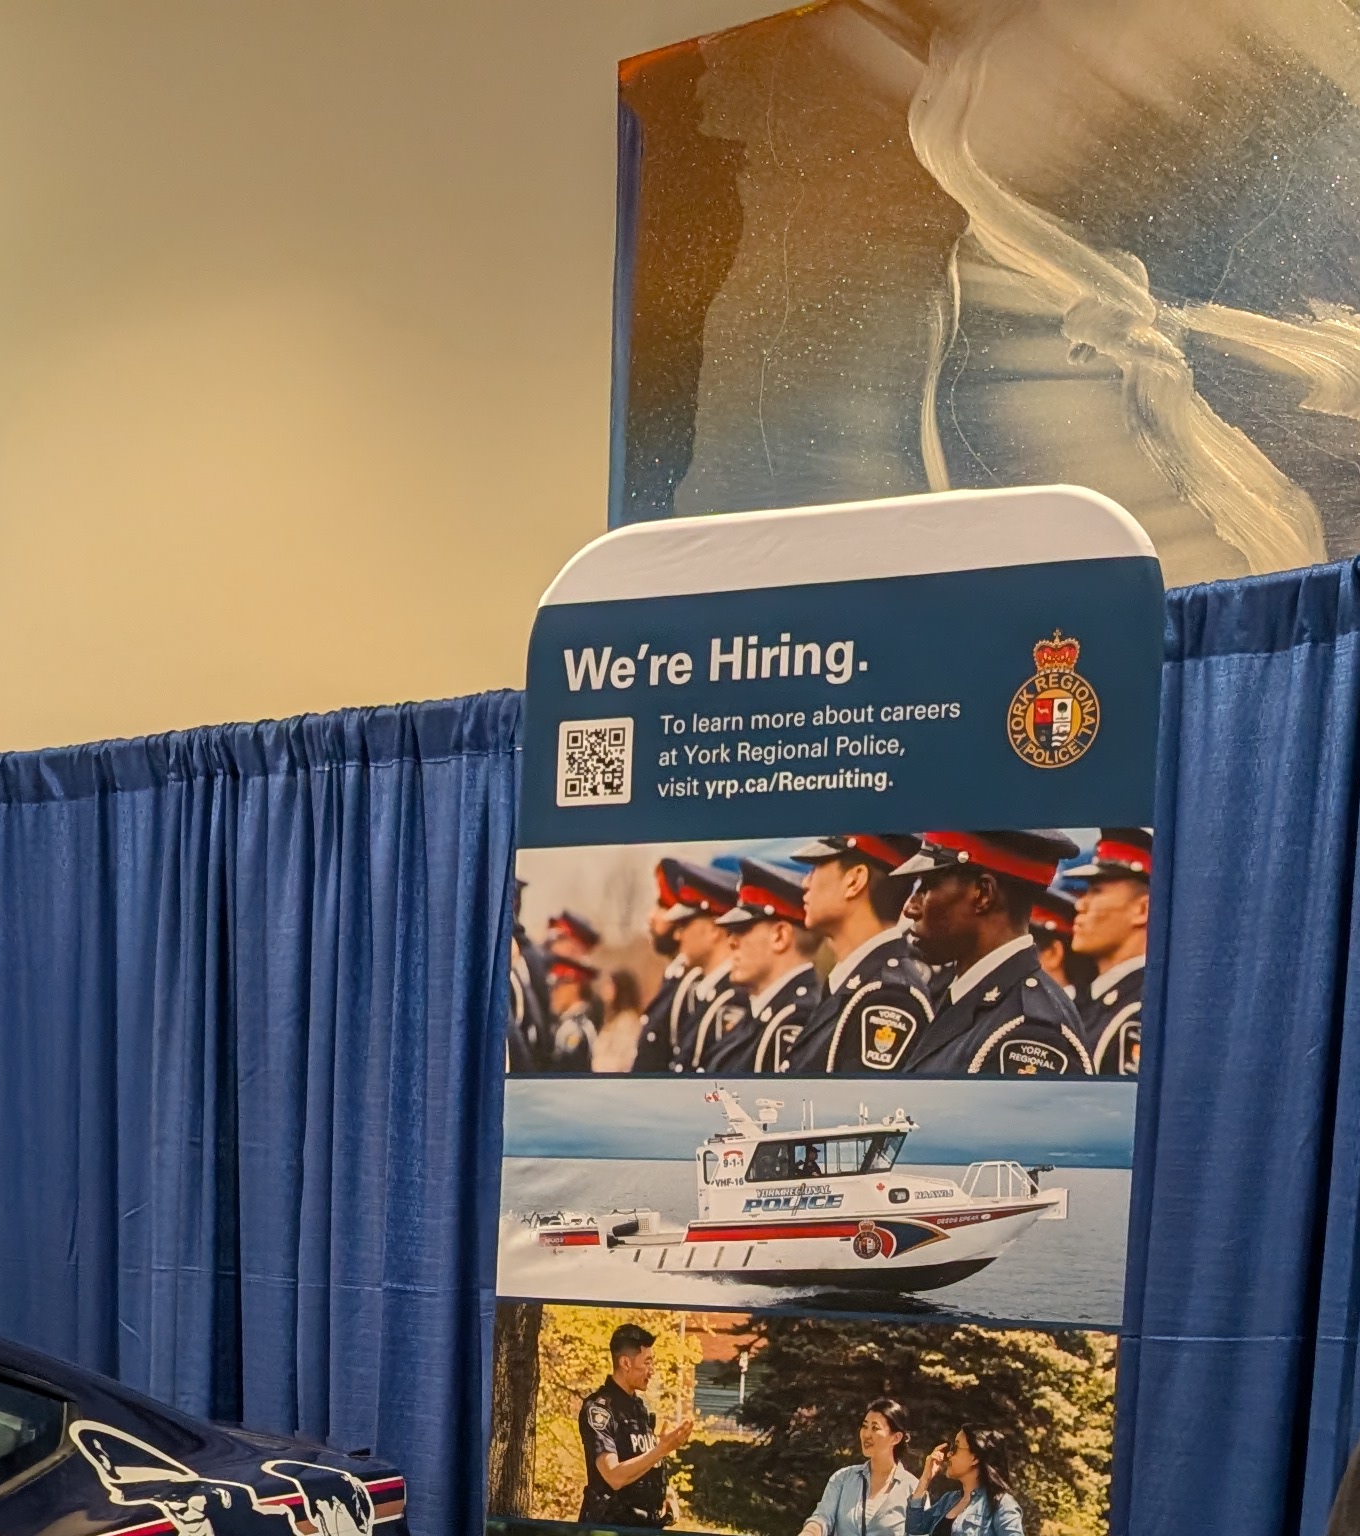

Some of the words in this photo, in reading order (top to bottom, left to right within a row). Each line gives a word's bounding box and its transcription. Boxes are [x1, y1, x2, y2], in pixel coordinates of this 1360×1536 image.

[564, 644, 692, 692] We're
[709, 633, 868, 684] Hiring.
[661, 715, 685, 735] To
[693, 712, 743, 732] learn
[751, 712, 805, 730] more
[813, 705, 873, 726] about
[881, 701, 960, 722] careers
[1011, 689, 1035, 745] YORK
[1035, 673, 1096, 736] REGIONAL
[659, 747, 677, 766] at
[684, 744, 730, 764] York
[738, 737, 828, 765] Regional
[836, 735, 905, 757] Police,
[1023, 742, 1080, 764] POLICE
[658, 778, 698, 797] visit
[705, 769, 893, 799] yrp.ca/Recruiting.
[1008, 1051, 1056, 1070] REGIONAL
[1020, 1045, 1049, 1060] YORK
[742, 1193, 844, 1213] POLICE
